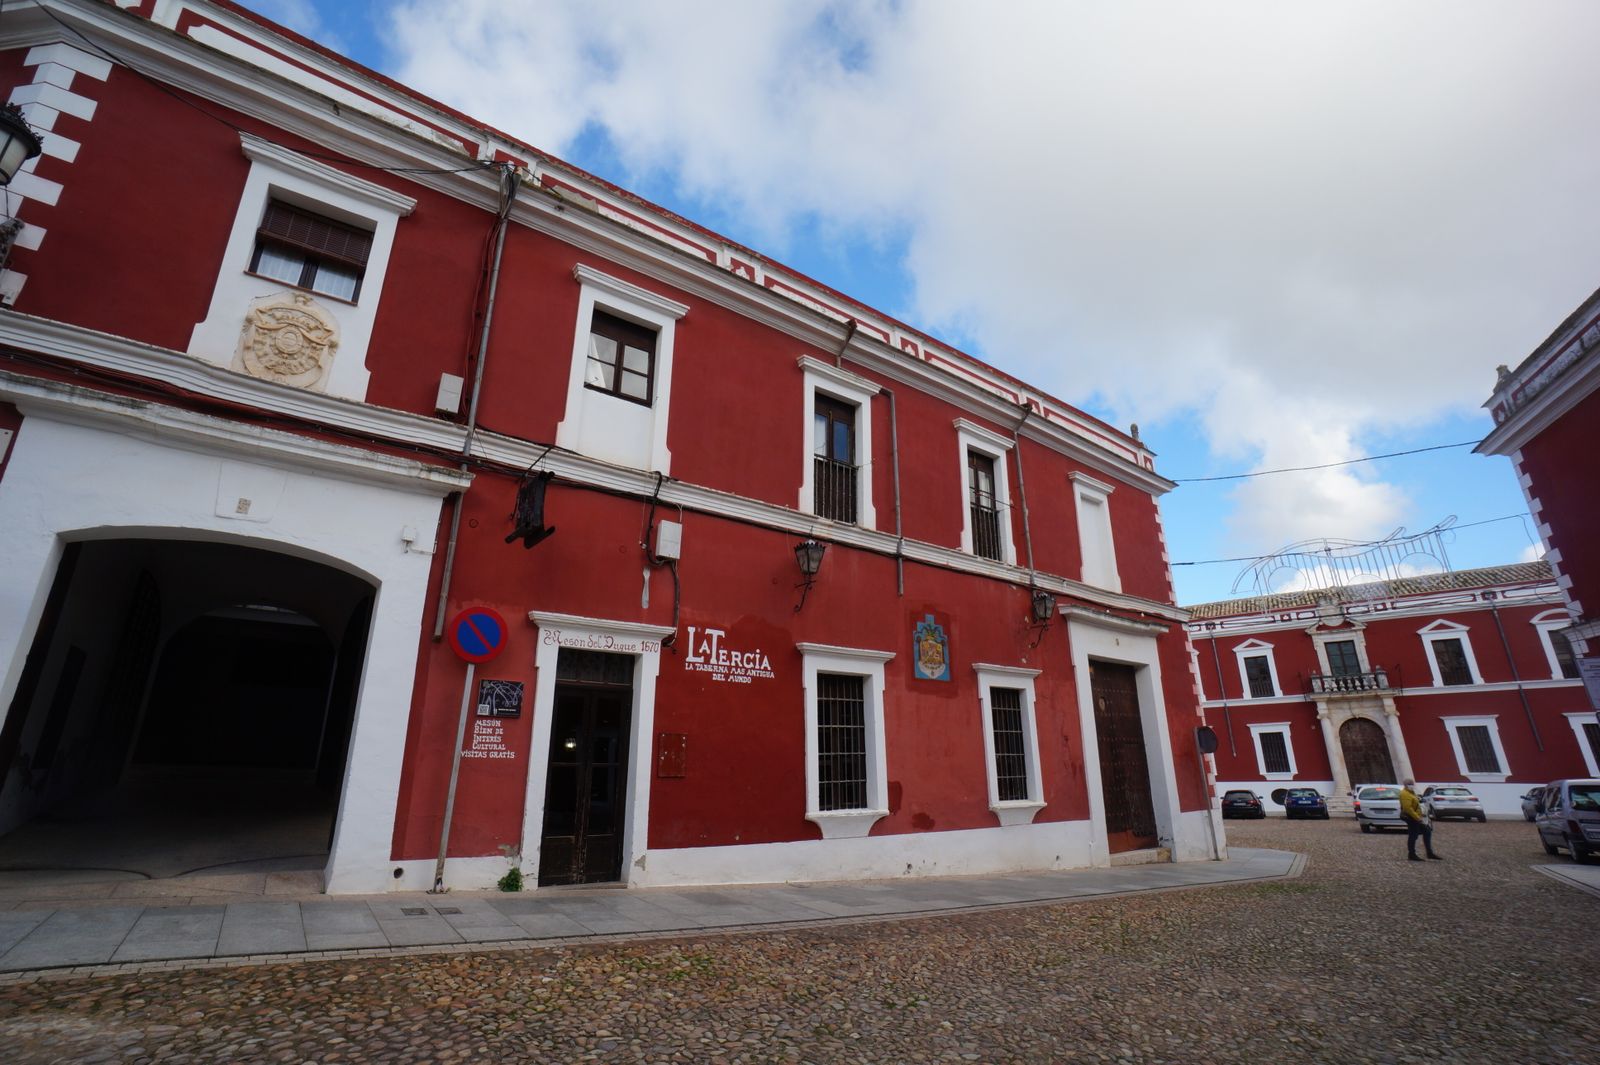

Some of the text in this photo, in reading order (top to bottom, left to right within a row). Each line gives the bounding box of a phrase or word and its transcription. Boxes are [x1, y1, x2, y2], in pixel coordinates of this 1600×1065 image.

[641, 640, 660, 653] 1670
[685, 626, 711, 662] LA
[685, 662, 694, 671] LA
[695, 663, 729, 674] TABERNA
[746, 669, 775, 679] ANTIGUA
[712, 673, 752, 684] DEL MUNDO
